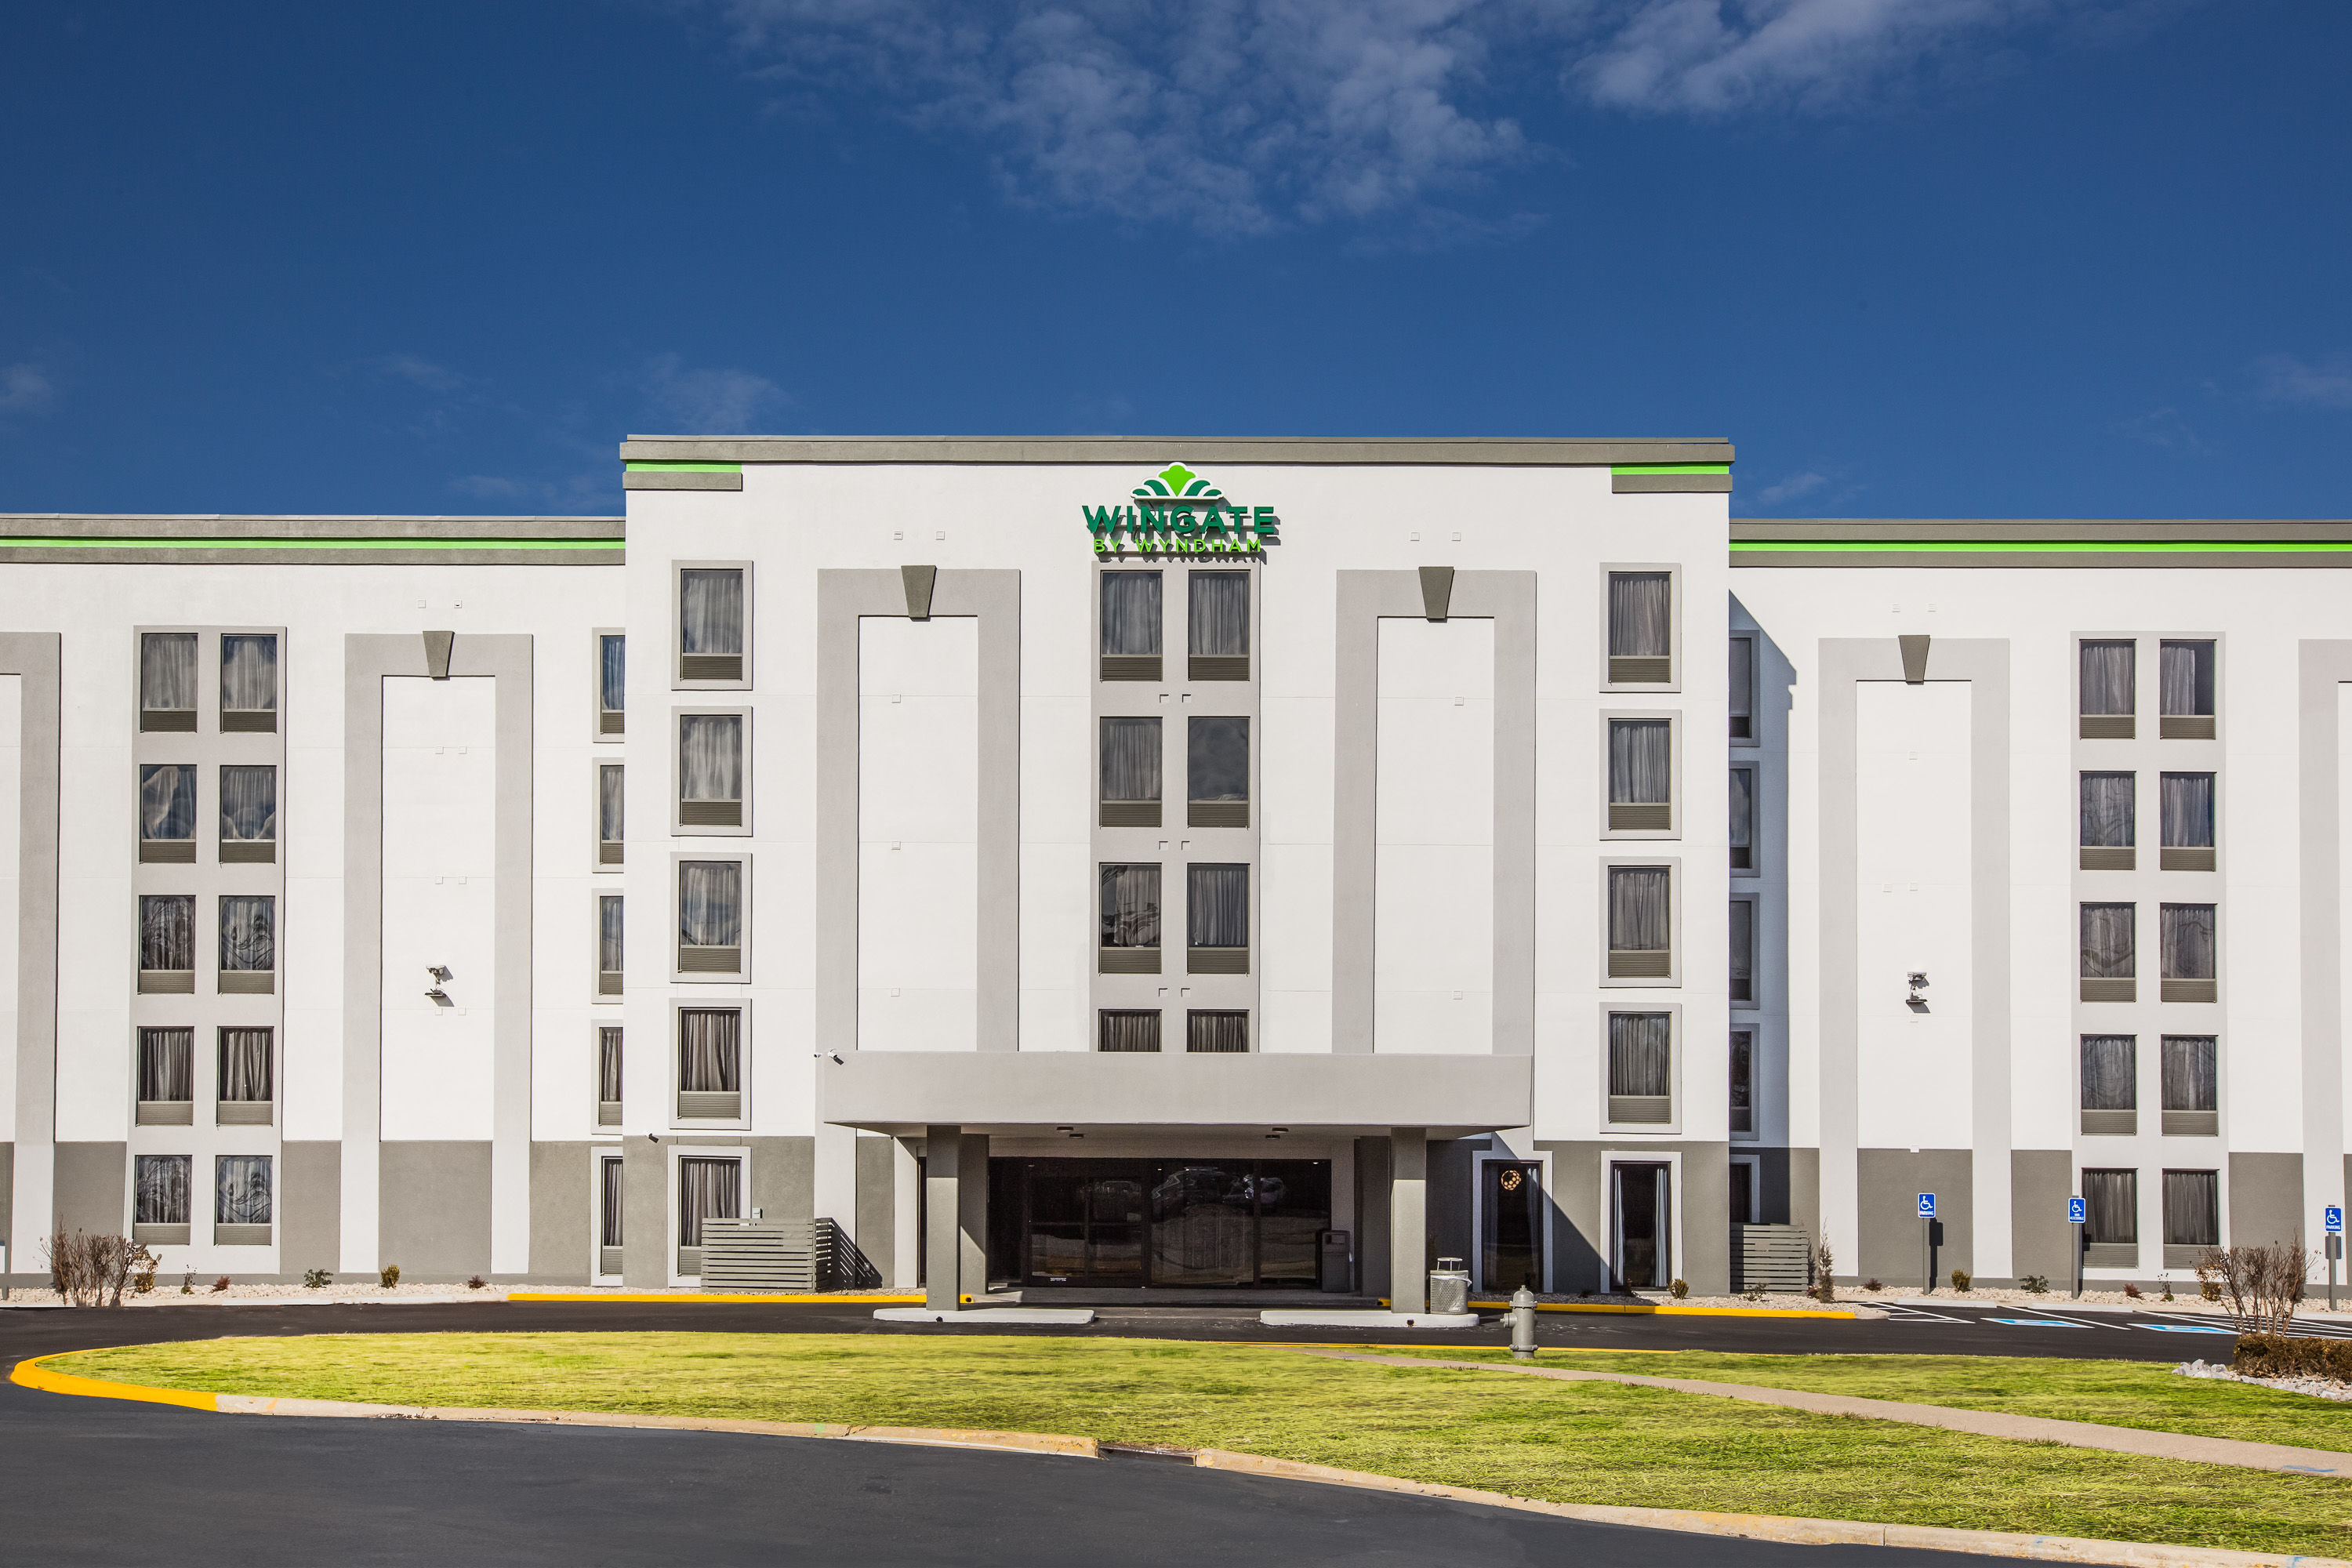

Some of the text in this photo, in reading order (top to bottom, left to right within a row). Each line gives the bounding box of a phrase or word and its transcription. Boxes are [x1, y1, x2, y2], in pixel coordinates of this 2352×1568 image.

[1082, 505, 1274, 534] WINGATE
[1093, 539, 1261, 554] BY WYNDHAM
